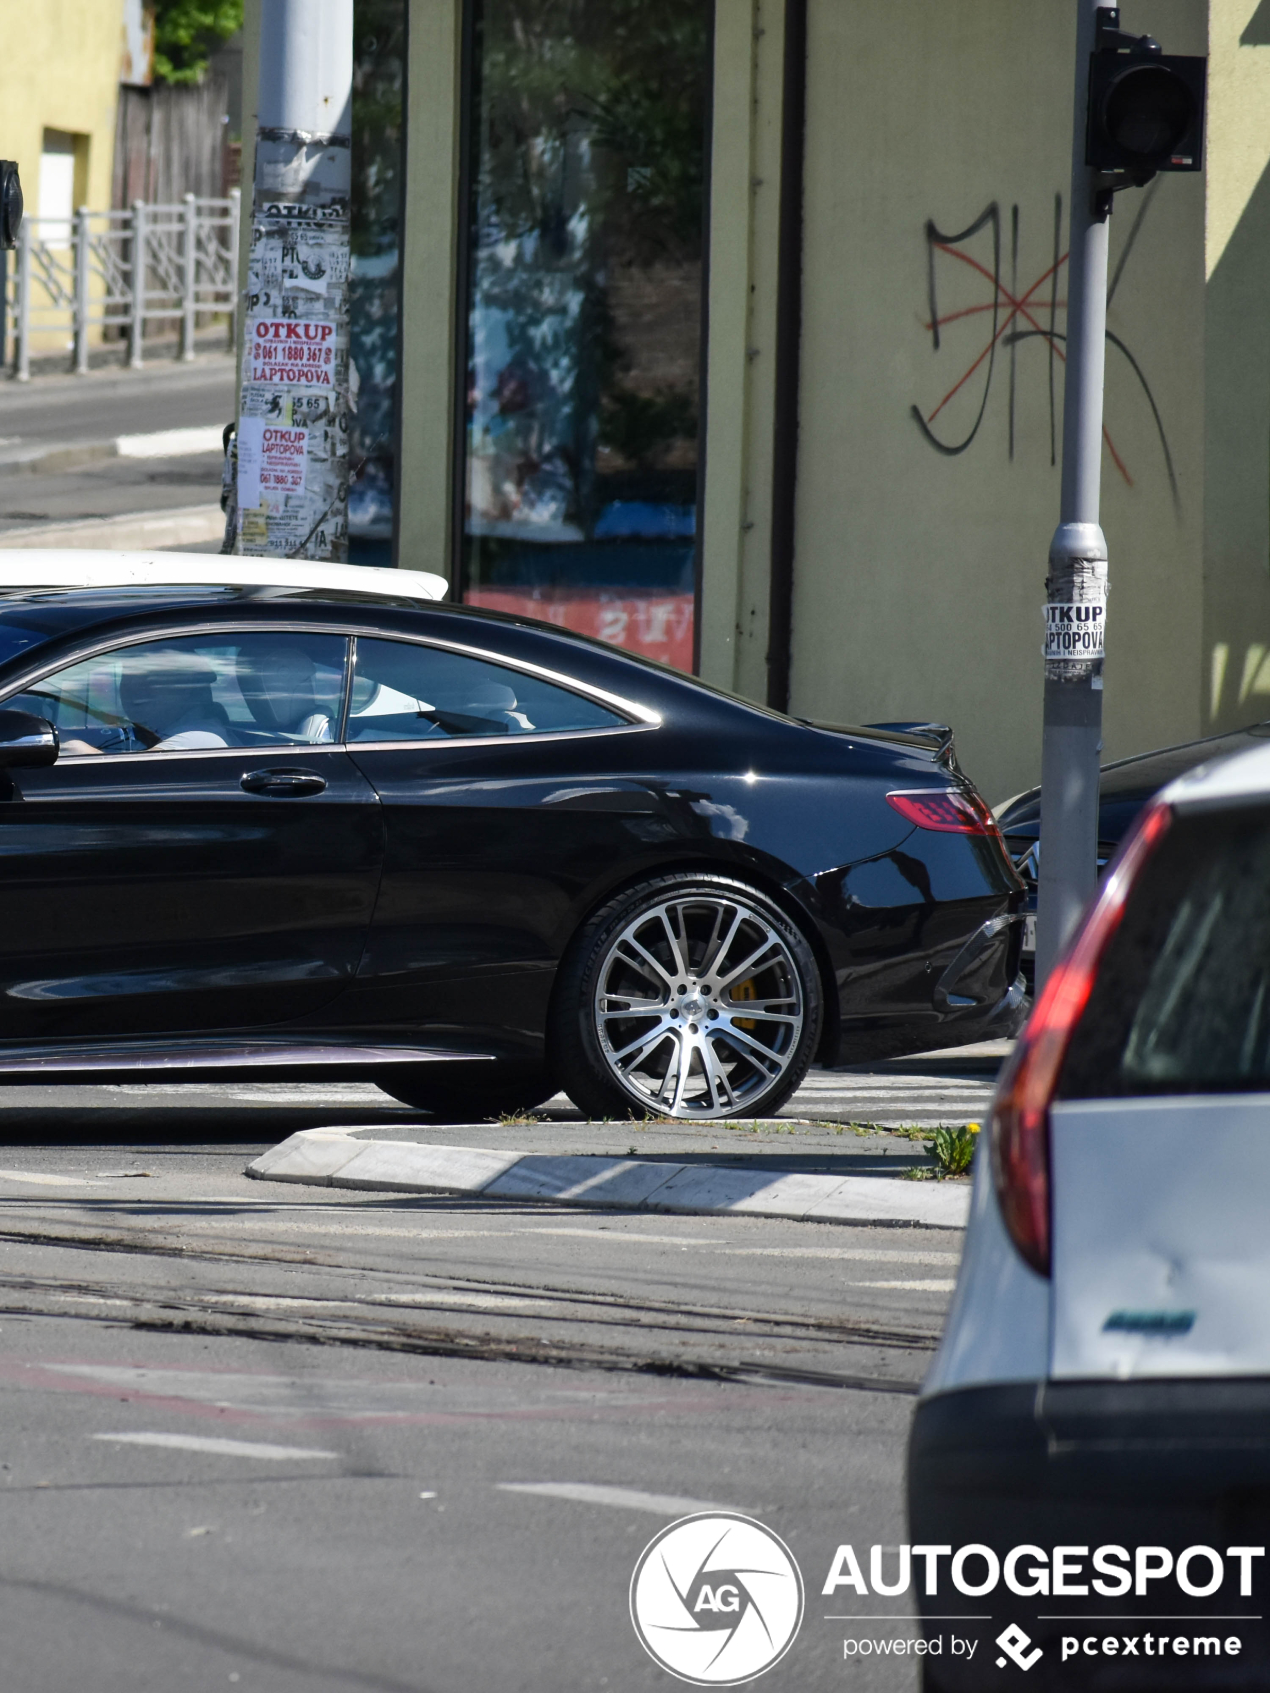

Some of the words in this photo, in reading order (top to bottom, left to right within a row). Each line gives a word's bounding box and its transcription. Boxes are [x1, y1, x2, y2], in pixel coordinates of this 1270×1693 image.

[256, 322, 332, 341] OTKUP
[263, 345, 278, 360] 061
[282, 346, 304, 361] 1880
[307, 347, 322, 362] 367
[253, 367, 330, 384] LAPTOPOVA
[307, 398, 320, 409] 65
[263, 429, 305, 443] OTKUP
[262, 442, 304, 456] LAPTOPOVA
[274, 475, 288, 484] 1880
[291, 476, 302, 485] 367
[1055, 623, 1072, 631] 500
[1077, 623, 1089, 631] 65
[1094, 623, 1103, 631] 65
